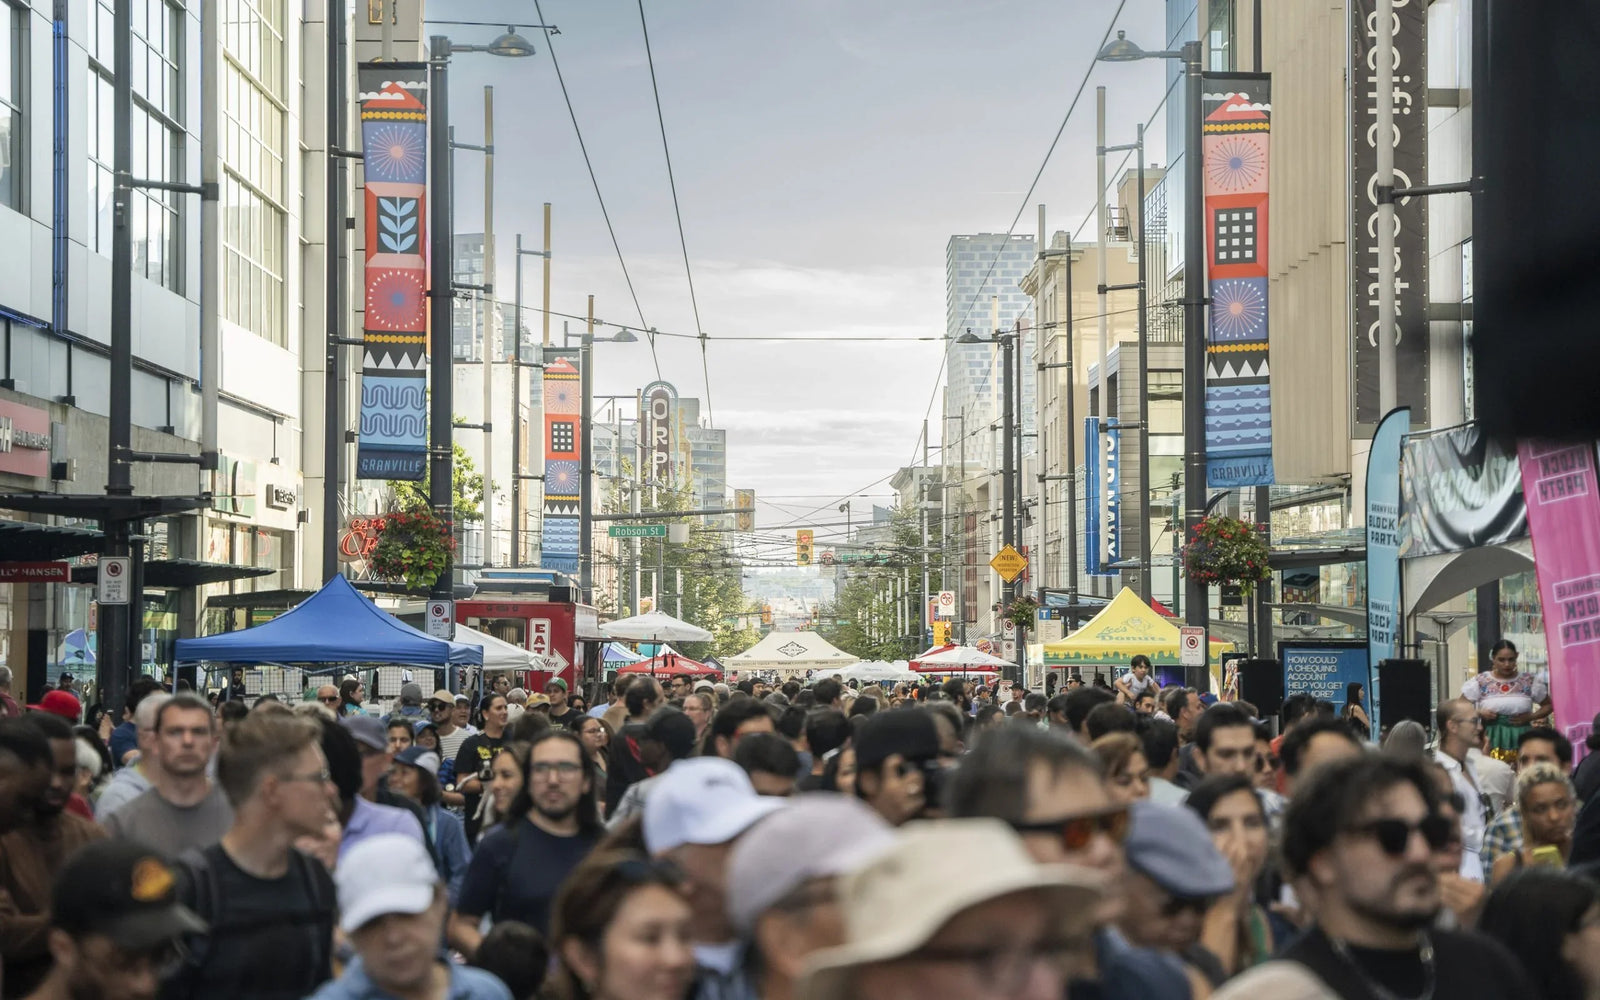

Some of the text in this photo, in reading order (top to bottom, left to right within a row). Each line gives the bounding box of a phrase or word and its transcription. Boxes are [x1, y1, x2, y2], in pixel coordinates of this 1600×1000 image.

[1367, 0, 1413, 348] acific Centre
[361, 458, 421, 473] GRANVILLE
[1211, 464, 1269, 481] GRANVILLE
[1368, 514, 1396, 529] BLOCK
[615, 526, 660, 536] Robson St
[22, 567, 65, 576] HANSEN
[1096, 634, 1167, 642] Donuts
[1287, 656, 1338, 664] HOW COULD
[1287, 664, 1337, 674] A CHEQUING
[1287, 673, 1328, 681] ACCOUNT
[1287, 681, 1344, 690] HELP YOU GET
